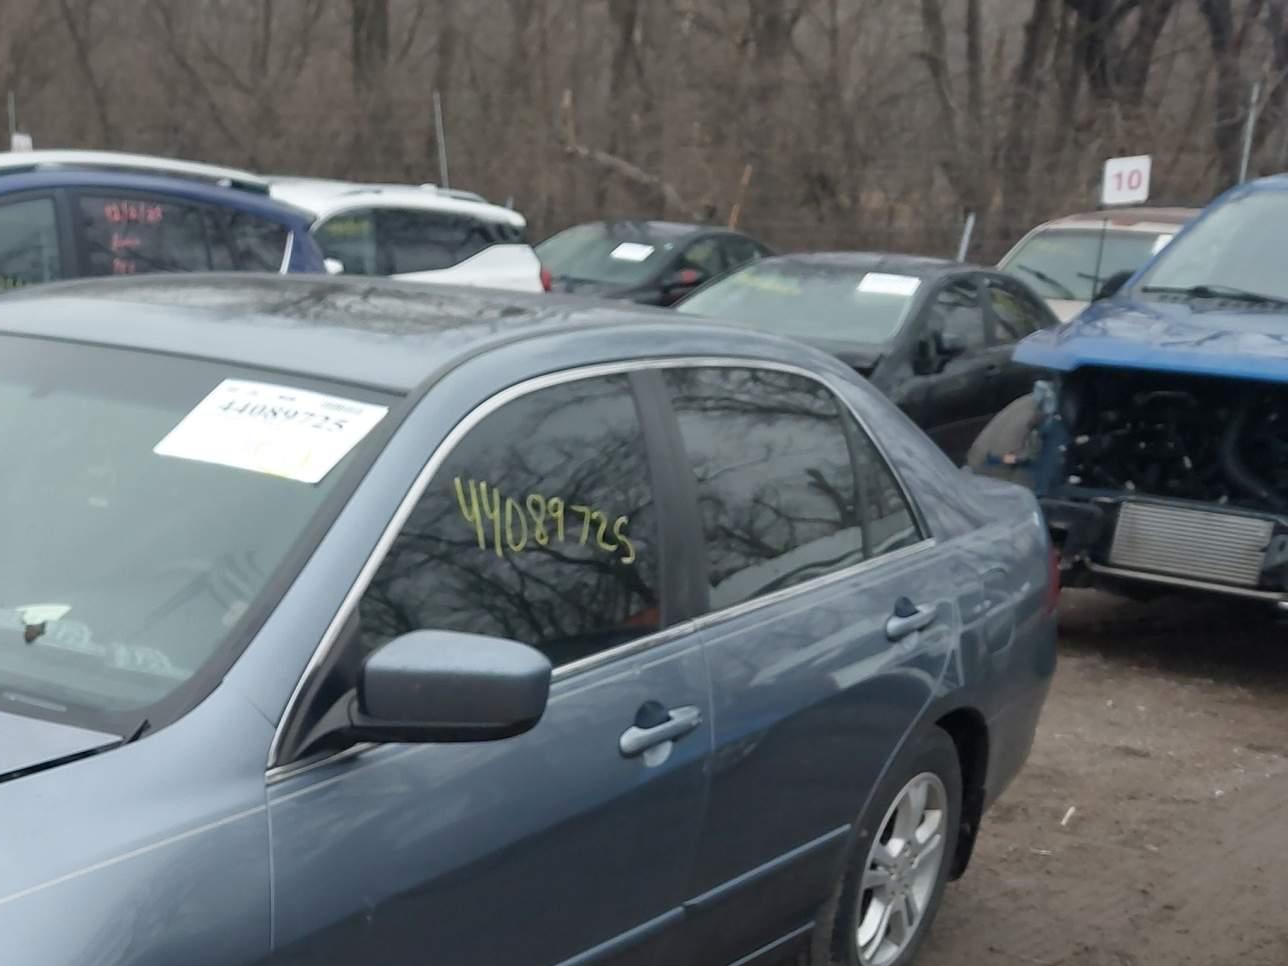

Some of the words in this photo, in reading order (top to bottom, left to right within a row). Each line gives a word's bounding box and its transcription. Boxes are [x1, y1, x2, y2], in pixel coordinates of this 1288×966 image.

[1113, 168, 1143, 191] 10
[218, 399, 349, 432] 44089725
[453, 477, 636, 564] 44089725
